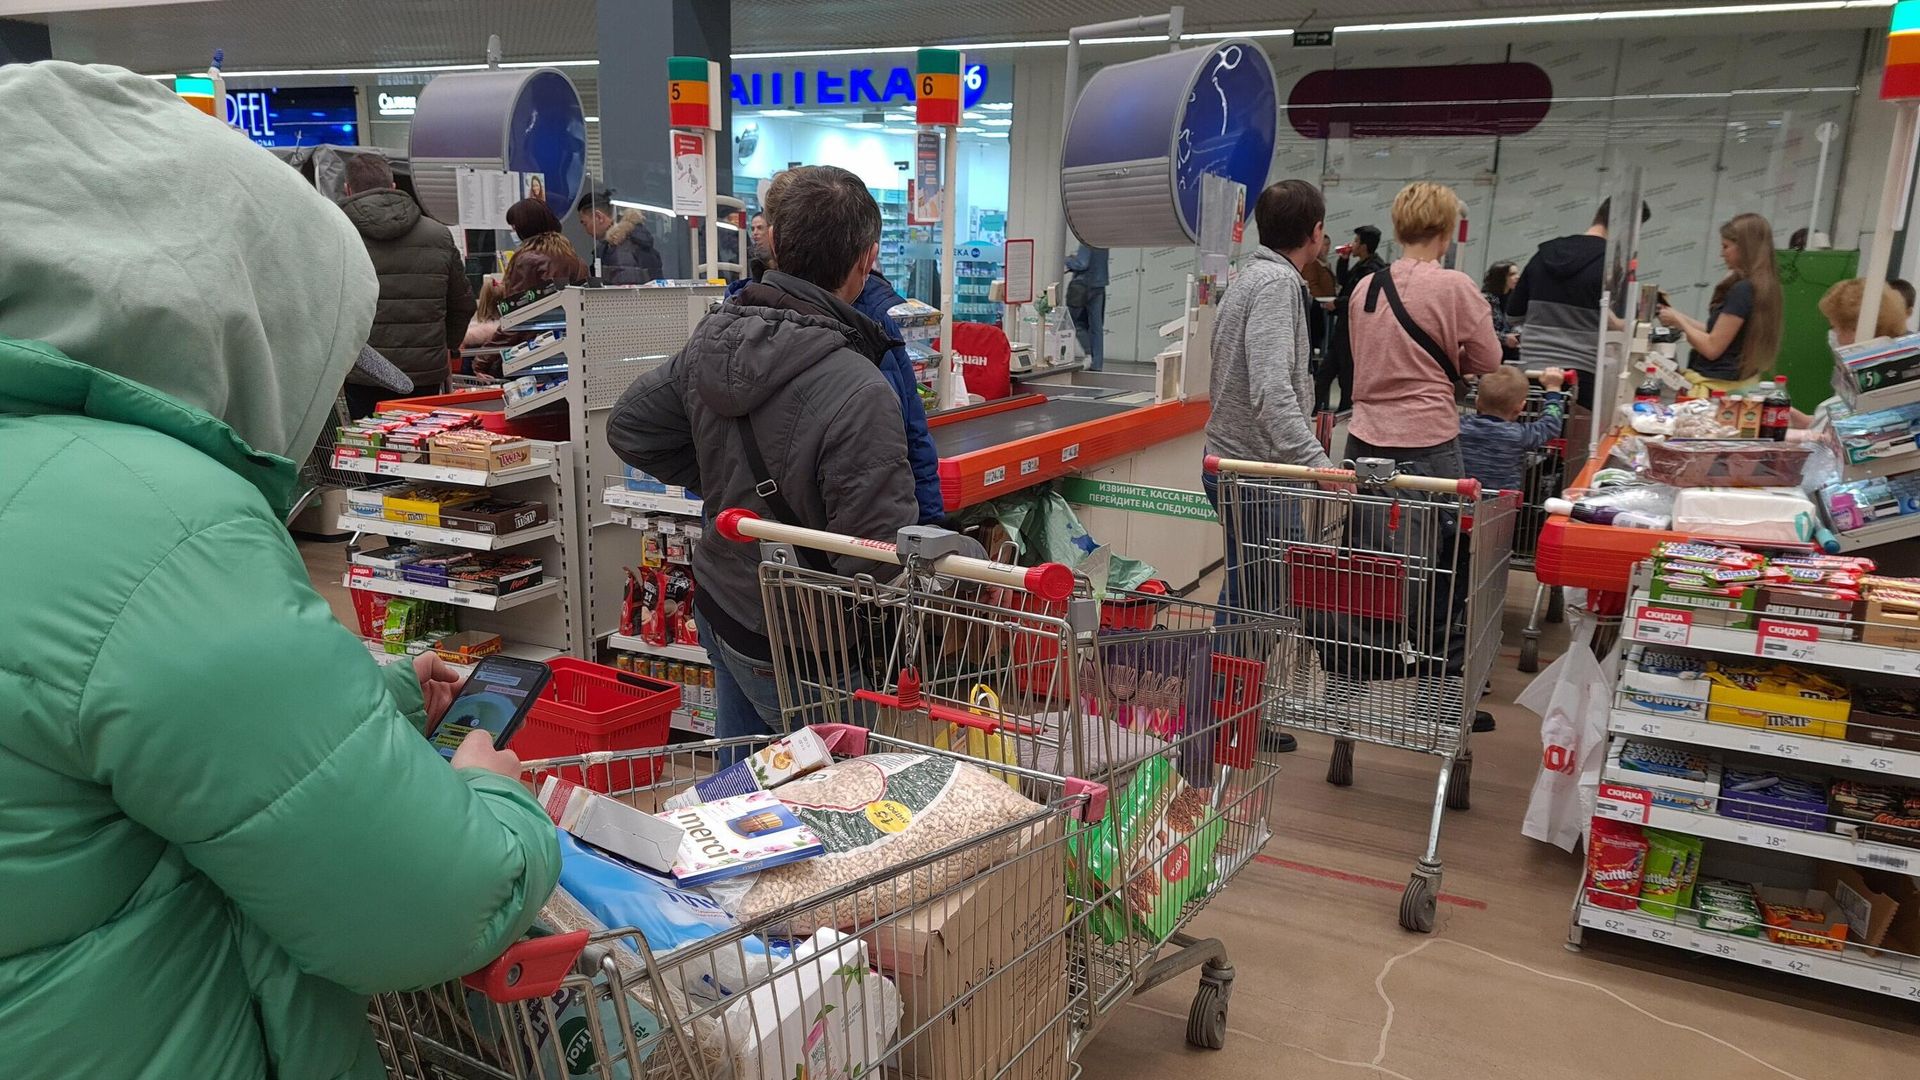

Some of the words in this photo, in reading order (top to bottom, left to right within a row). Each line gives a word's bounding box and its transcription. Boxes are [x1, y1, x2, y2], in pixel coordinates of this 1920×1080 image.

[671, 82, 681, 101] 5
[922, 76, 934, 96] 6
[1088, 492, 1141, 510] ПЕРЕЙДИТЕ
[1142, 500, 1155, 510] НА
[1099, 483, 1149, 499] ИЗВИНИТЕ,
[1150, 489, 1180, 502] КАССА
[1181, 493, 1194, 503] НЕ
[1645, 610, 1684, 623] СКИДКА
[1767, 624, 1809, 639] СКИДКА
[1606, 788, 1644, 801] СКИДКА
[1651, 791, 1676, 803] NTY
[677, 812, 730, 860] merci
[1595, 868, 1640, 882] Skittles
